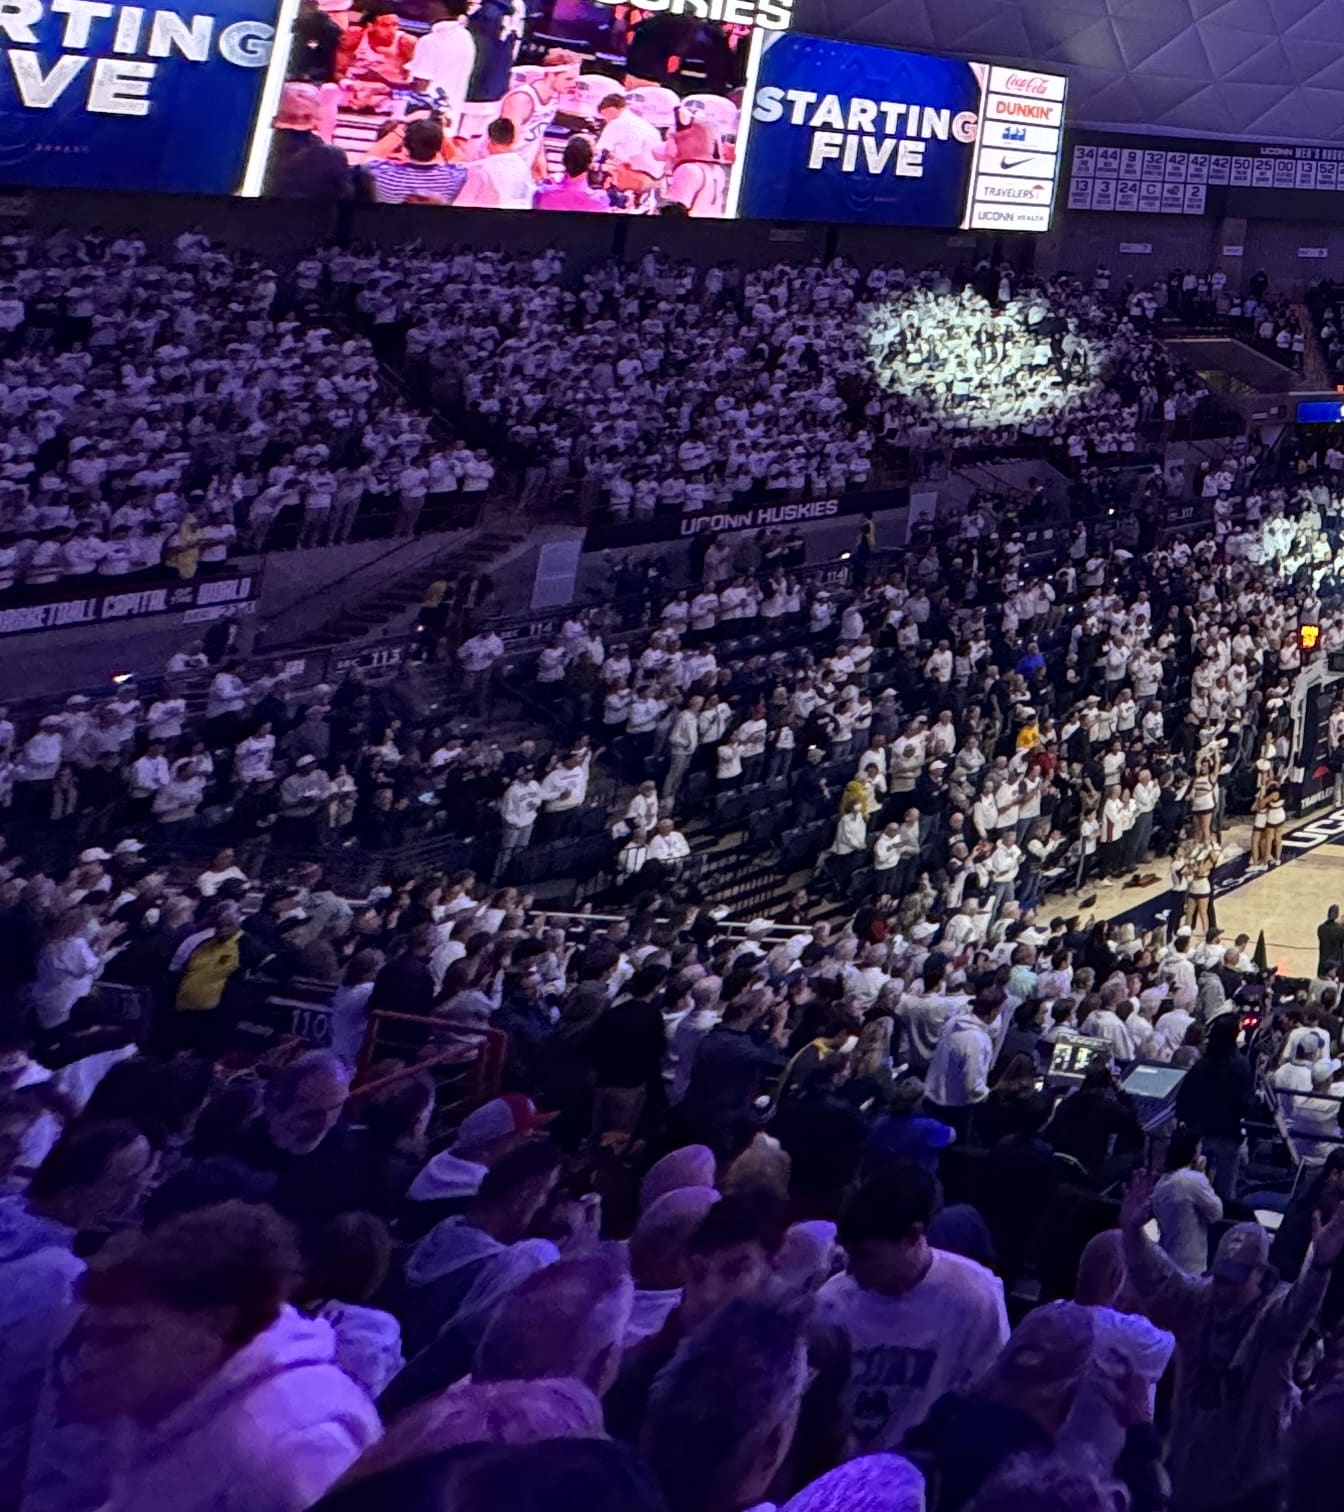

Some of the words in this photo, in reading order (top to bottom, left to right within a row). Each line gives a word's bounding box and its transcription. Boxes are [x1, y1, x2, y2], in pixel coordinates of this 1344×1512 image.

[752, 85, 978, 143] STARTING
[996, 100, 1053, 120] DUNKIN'
[807, 129, 926, 178] FIVE
[1076, 147, 1094, 159] 34
[1101, 149, 1118, 161] 44
[1146, 152, 1163, 163] 32
[1319, 162, 1335, 173] 52
[984, 186, 1034, 199] TRAVELERS
[1119, 182, 1137, 193] 24
[978, 211, 1014, 222] UCONN
[680, 512, 752, 536] UCONN
[757, 499, 839, 524] HUSKIES
[102, 588, 169, 618] CAPITAL
[197, 577, 252, 605] WORLD
[371, 649, 402, 667] 113
[291, 1009, 328, 1038] 110
